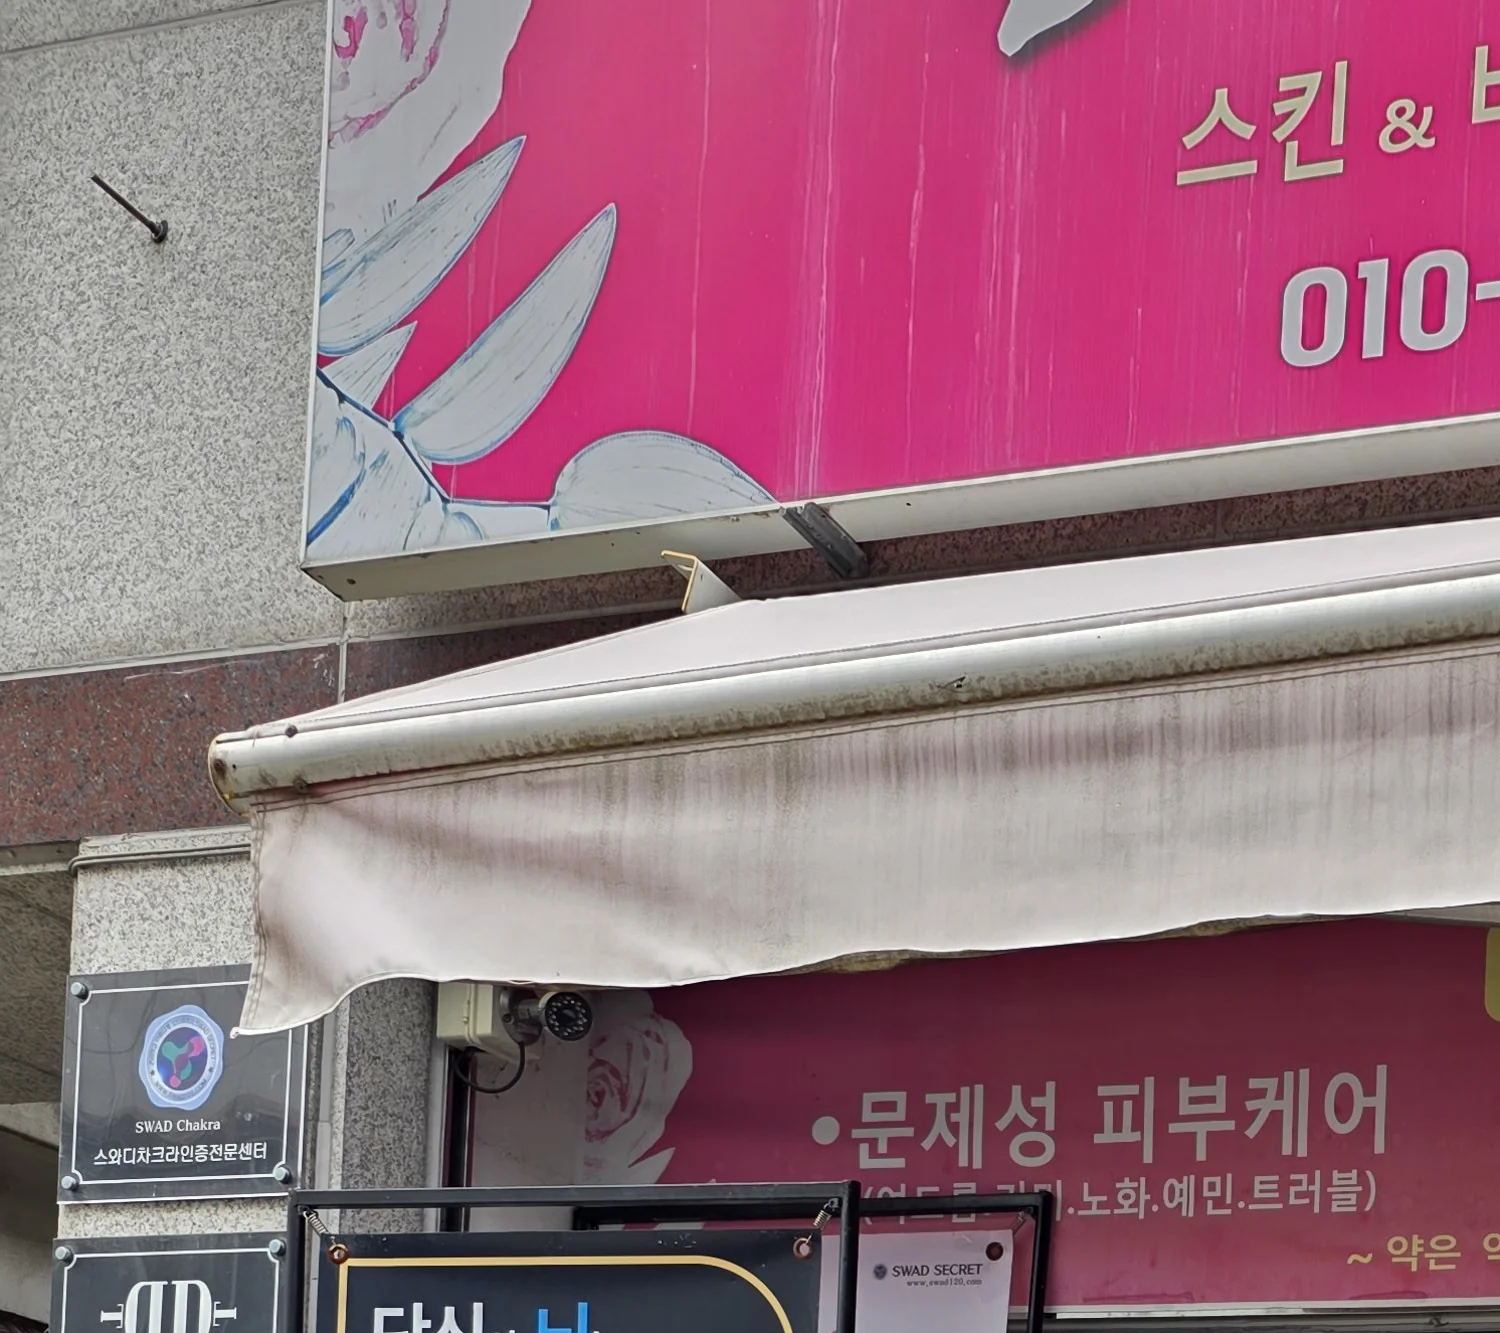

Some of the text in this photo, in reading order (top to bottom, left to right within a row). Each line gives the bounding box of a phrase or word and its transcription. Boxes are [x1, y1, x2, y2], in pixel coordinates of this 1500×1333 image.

[1176, 60, 1349, 187] 스킨
[1377, 97, 1437, 155] &
[135, 1118, 221, 1134] SWAD Chakra
[850, 1063, 1389, 1171] 문제성 피부케어
[93, 1141, 268, 1166] 스와디차크라인증전문센터
[891, 1263, 984, 1278] SWAD SECRET
[1387, 1234, 1462, 1275] 약은
